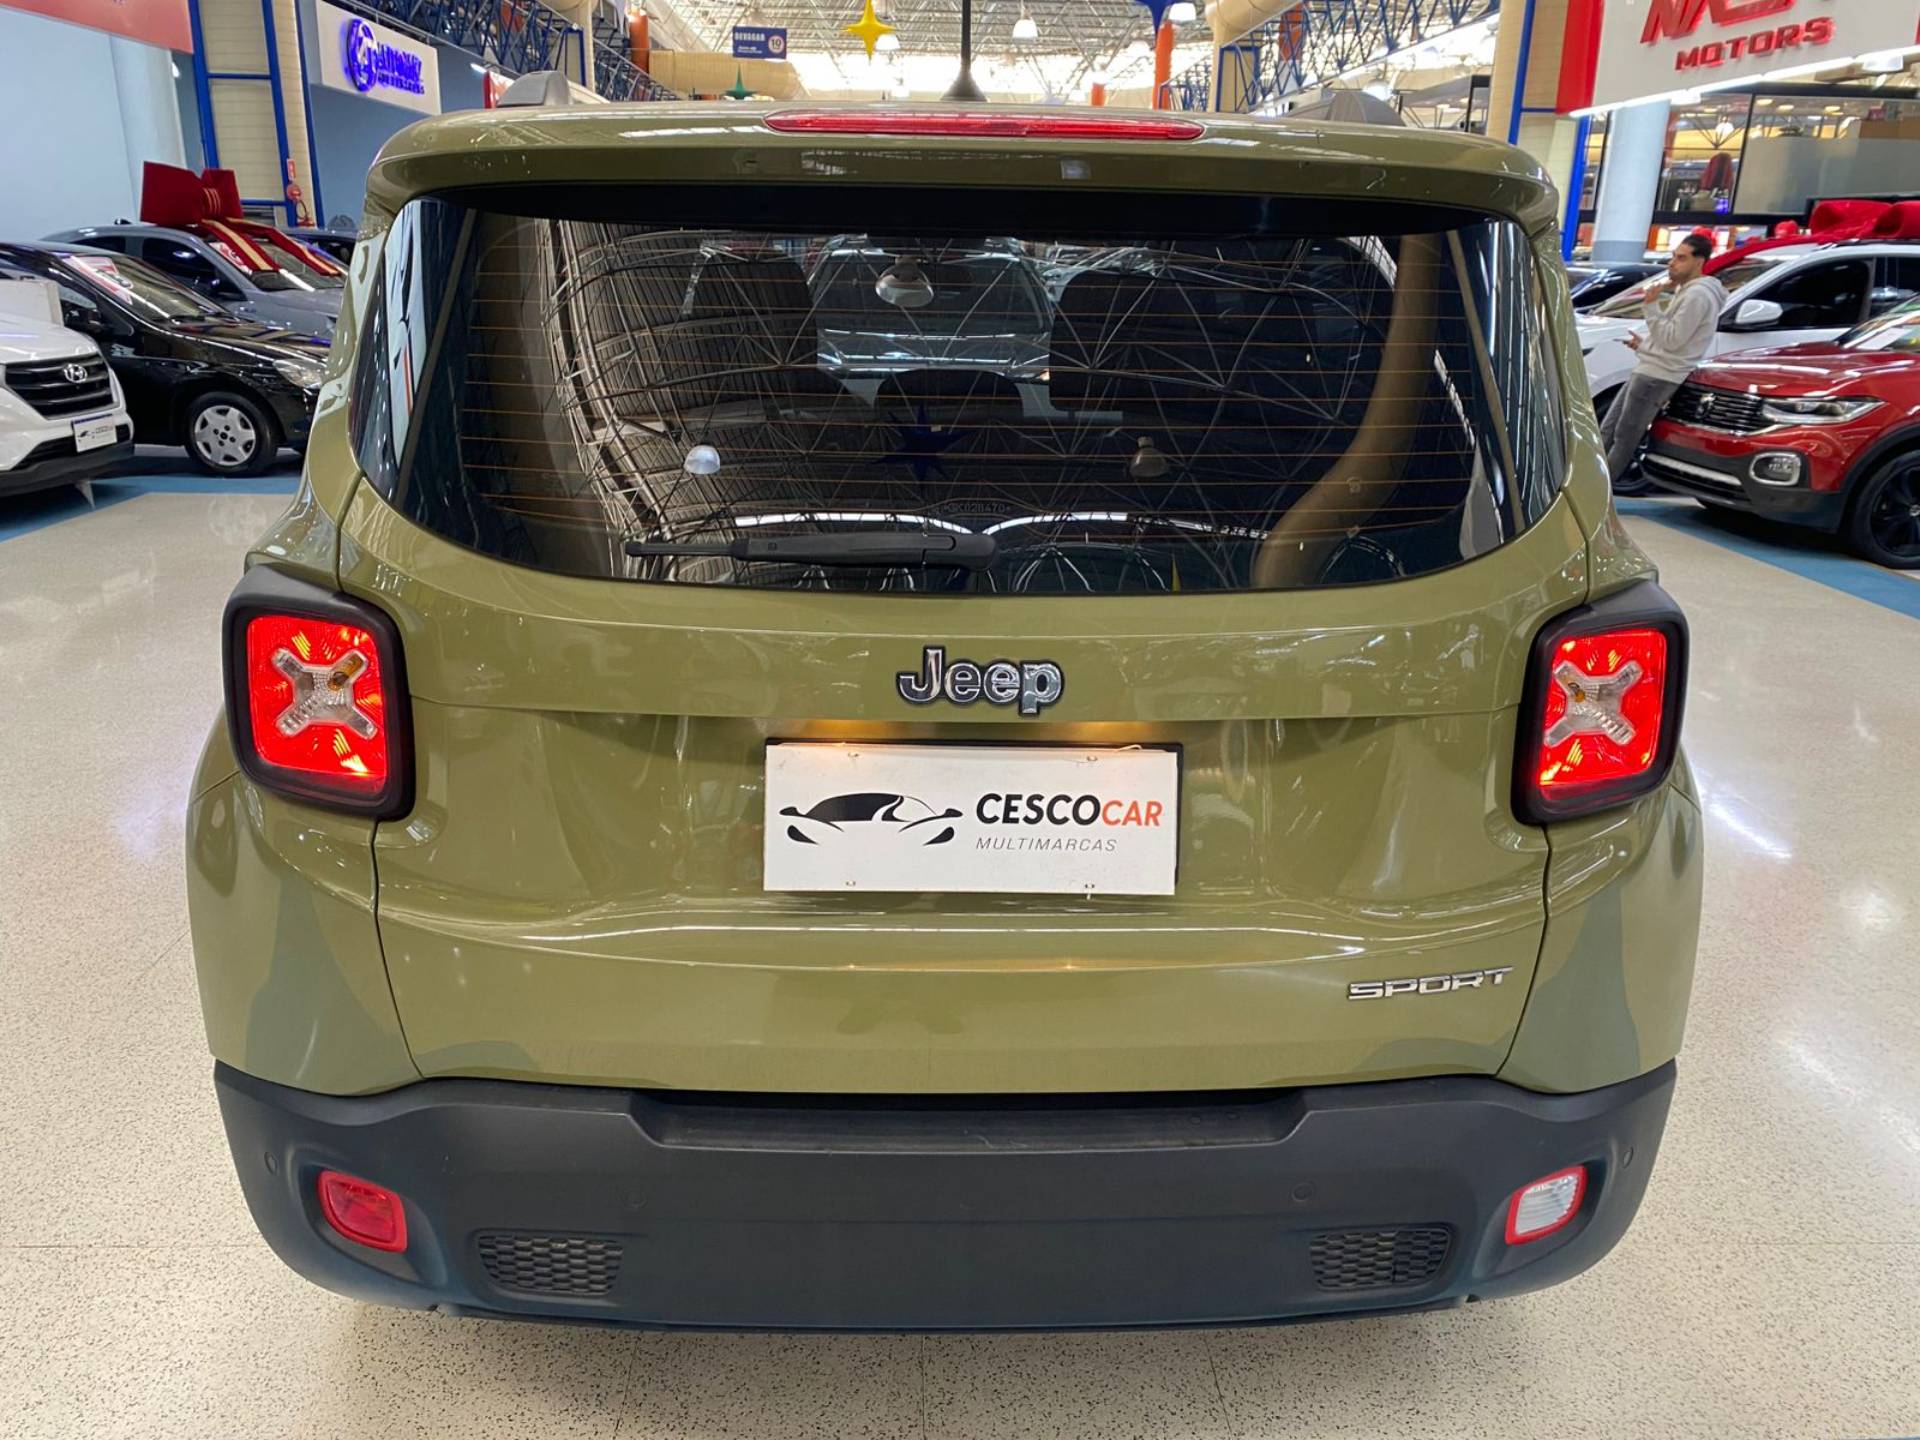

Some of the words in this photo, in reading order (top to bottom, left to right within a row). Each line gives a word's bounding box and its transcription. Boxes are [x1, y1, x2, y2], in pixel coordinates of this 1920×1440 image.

[1675, 16, 1835, 71] MOTORS
[897, 646, 1064, 715] Jeep
[976, 793, 1163, 827] CESCOCAR
[976, 837, 1118, 851] MULTIMARCAS
[1348, 966, 1514, 1000] SPORT
